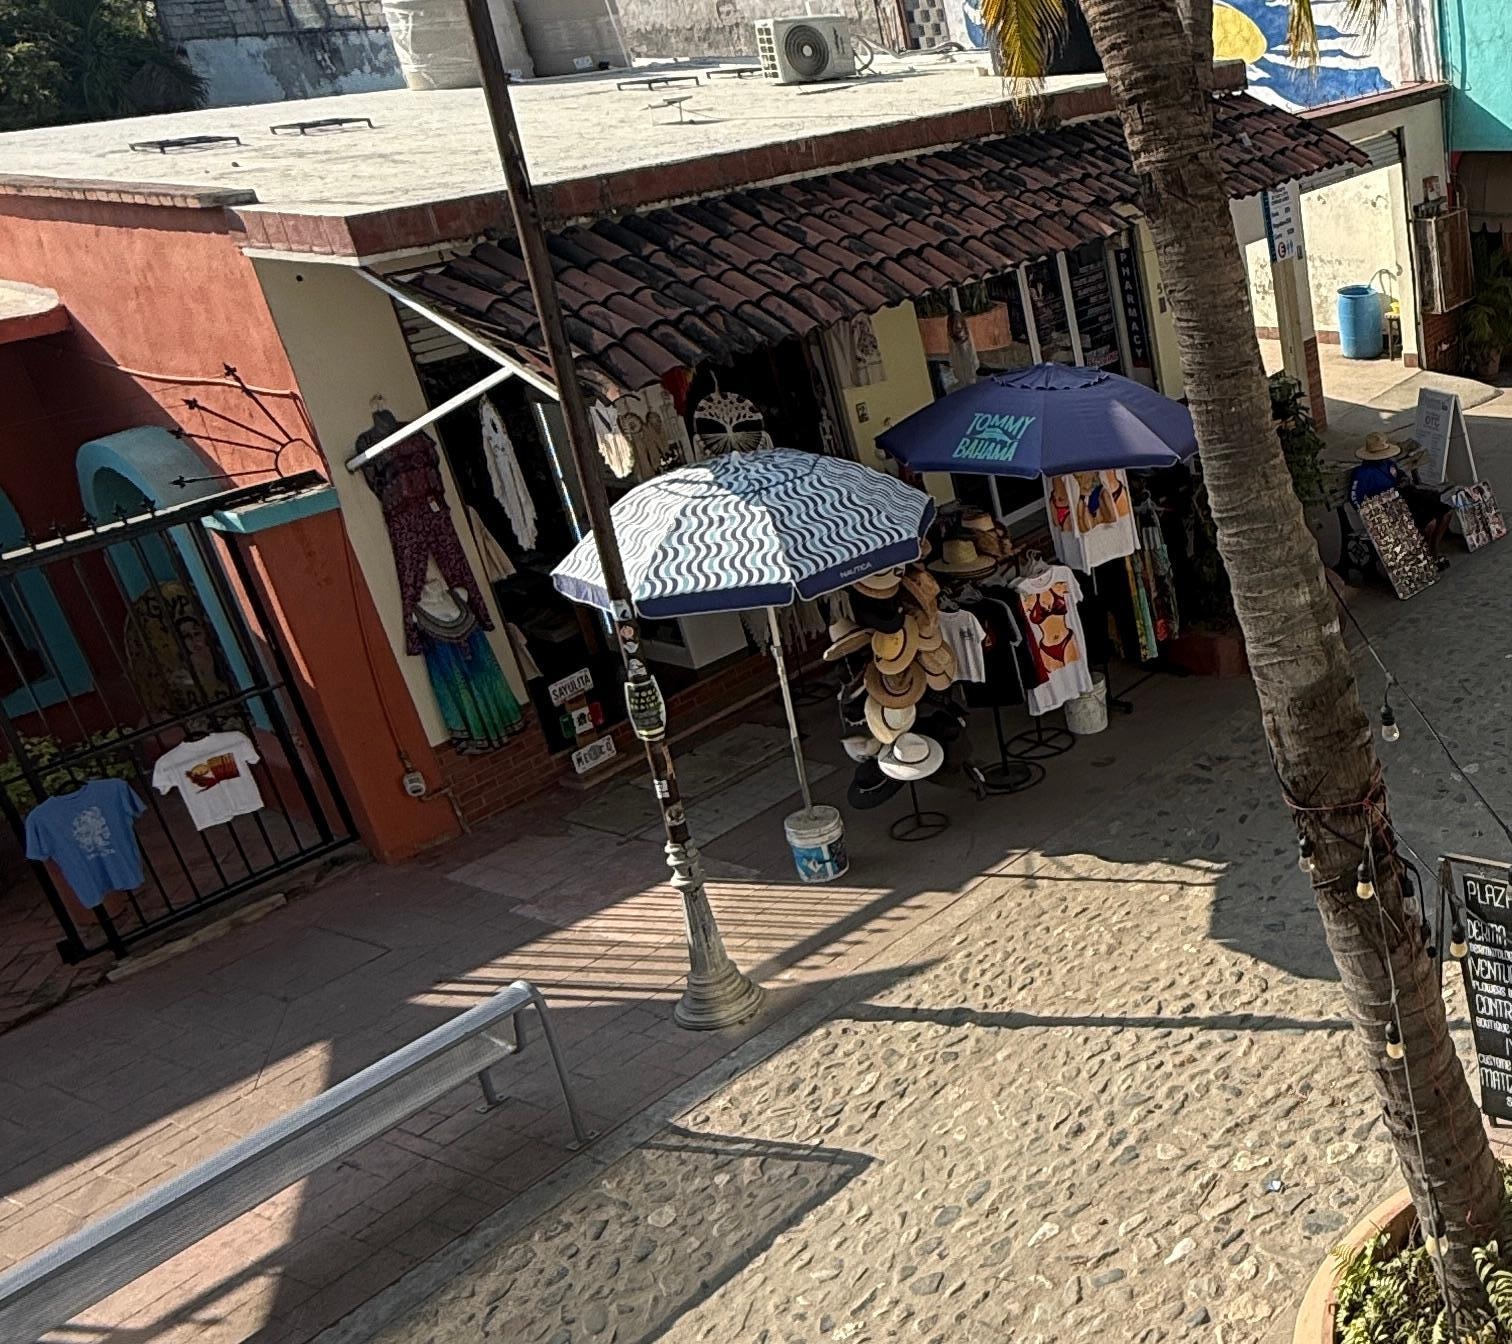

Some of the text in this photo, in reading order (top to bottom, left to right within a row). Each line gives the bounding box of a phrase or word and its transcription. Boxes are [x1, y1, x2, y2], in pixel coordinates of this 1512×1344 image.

[1119, 252, 1142, 357] PHARMACY
[966, 412, 1036, 440] TOMMY
[952, 437, 1019, 461] BAHAMA
[552, 674, 591, 701] SAYULITA
[1476, 1016, 1511, 1034] BOUTIQUE
